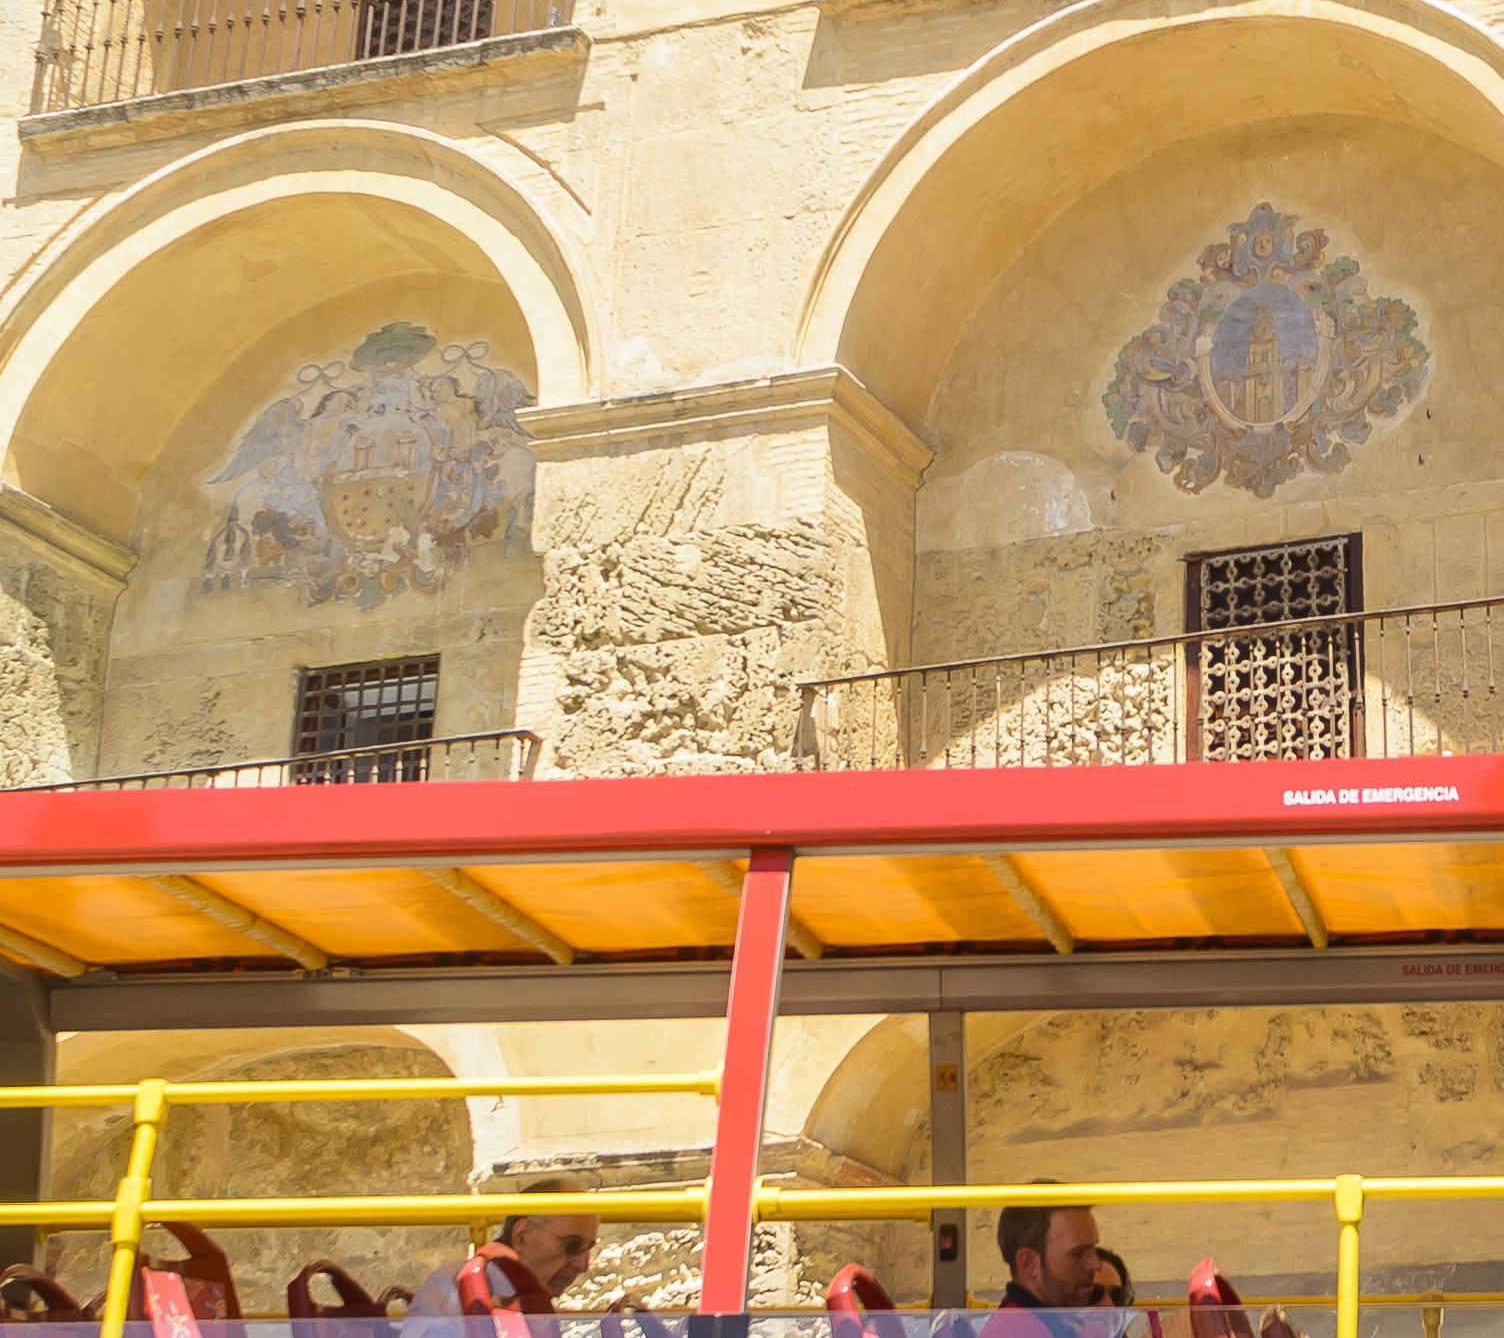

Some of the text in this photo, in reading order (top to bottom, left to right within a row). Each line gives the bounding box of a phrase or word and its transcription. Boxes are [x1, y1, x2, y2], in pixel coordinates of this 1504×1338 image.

[1283, 786, 1460, 806] SALIDA DE EMERGENCIA
[1402, 964, 1444, 976] SALIDA
[1446, 963, 1462, 975] DE
